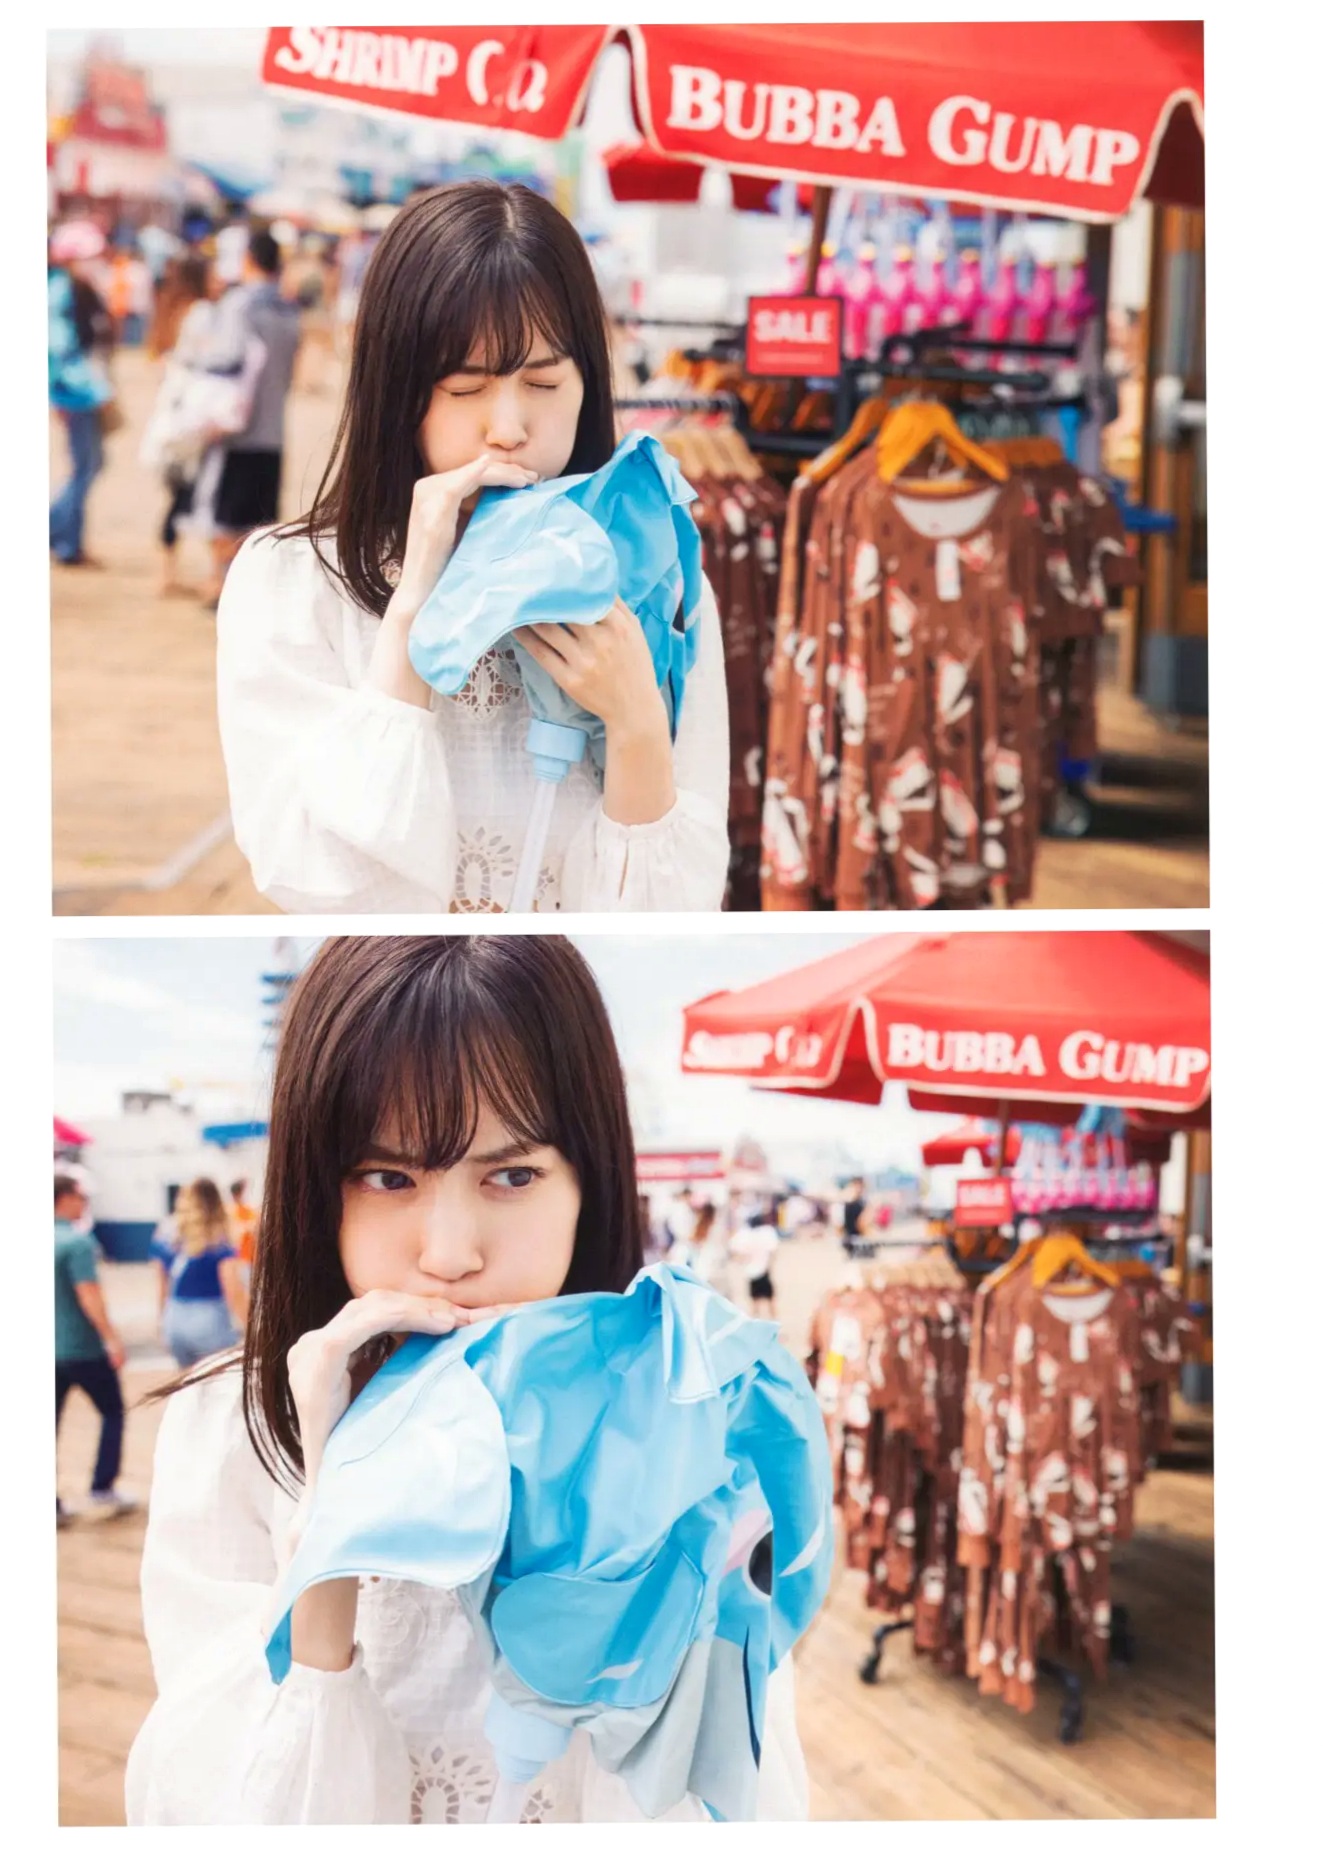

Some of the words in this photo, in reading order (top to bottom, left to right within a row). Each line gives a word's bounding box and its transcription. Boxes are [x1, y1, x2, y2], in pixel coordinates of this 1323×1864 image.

[274, 26, 459, 96] SHRIMP
[667, 64, 906, 156] BUBBA
[928, 95, 1140, 186] GUMP
[753, 309, 832, 343] SALE
[887, 1023, 1046, 1077] BUBBA
[1058, 1030, 1210, 1087] GUMP
